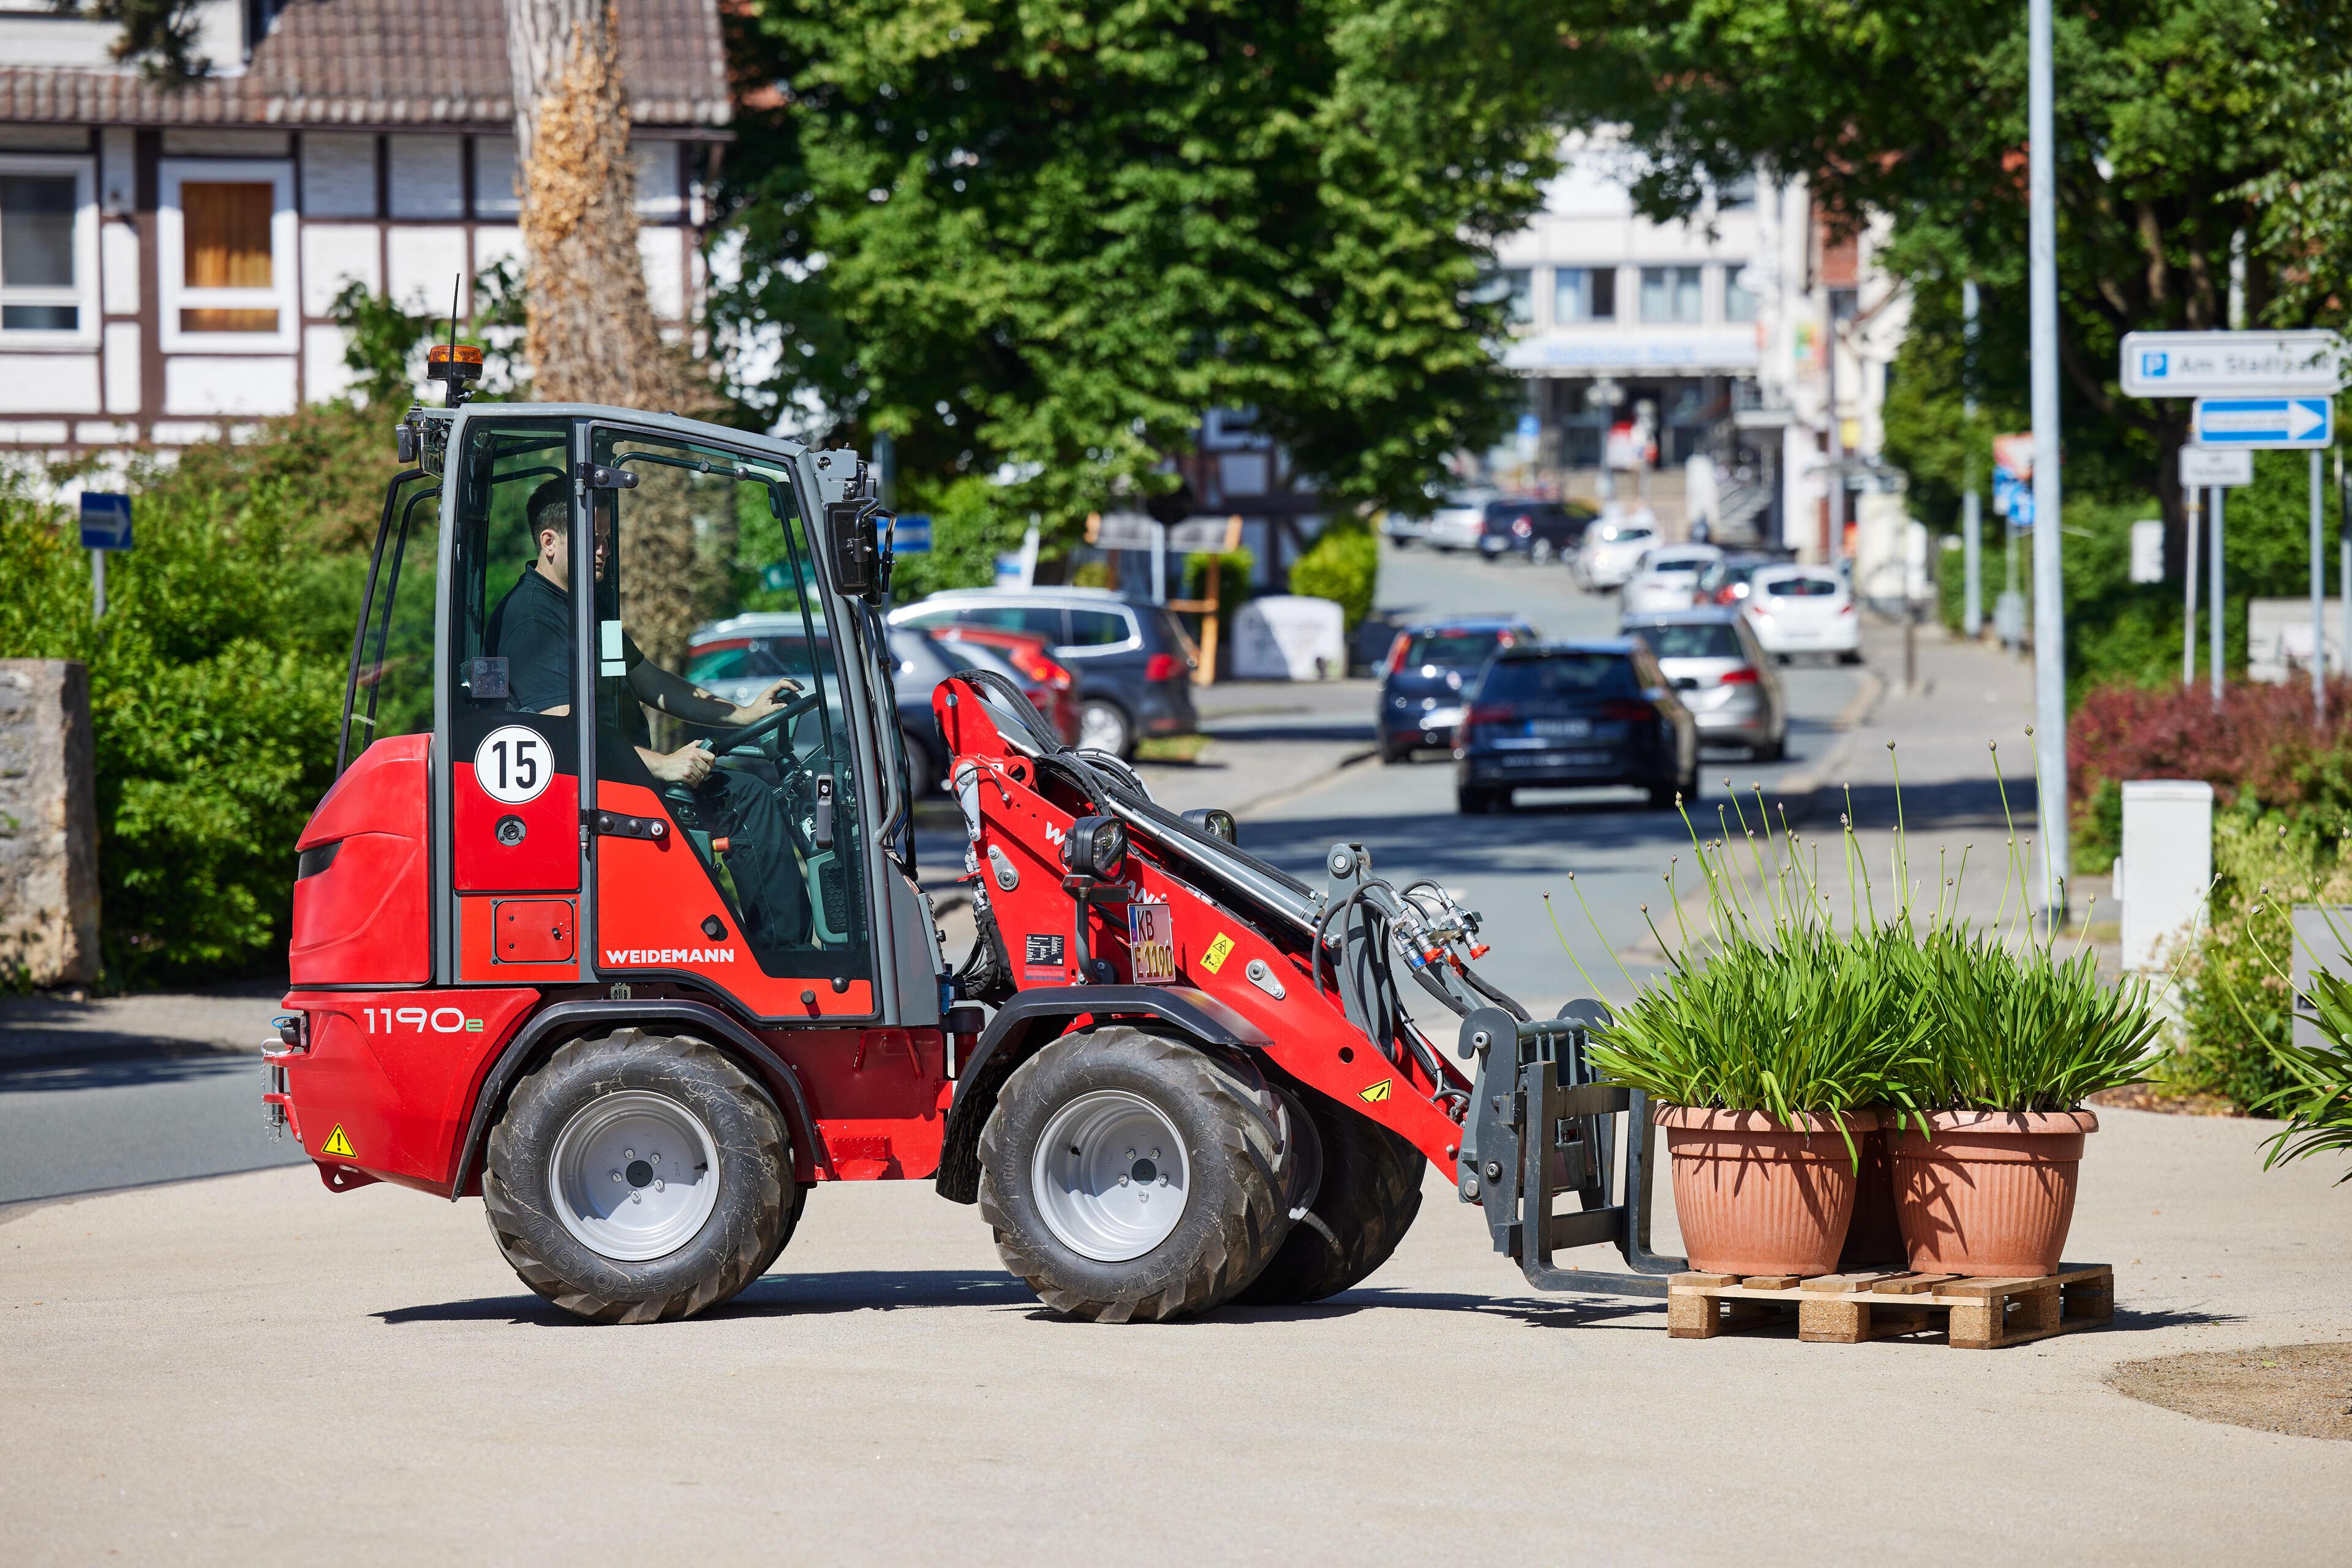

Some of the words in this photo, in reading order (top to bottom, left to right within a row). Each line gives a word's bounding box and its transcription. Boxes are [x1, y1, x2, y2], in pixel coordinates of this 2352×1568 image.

[492, 741, 537, 789] 15
[1136, 910, 1155, 941] KB
[606, 949, 734, 964] WEIDEMANN
[1134, 946, 1144, 978] E
[1144, 945, 1174, 978] 1190
[1200, 1159, 1218, 1194] AS
[517, 1158, 562, 1256] DUMPER
[554, 1250, 593, 1279] AS
